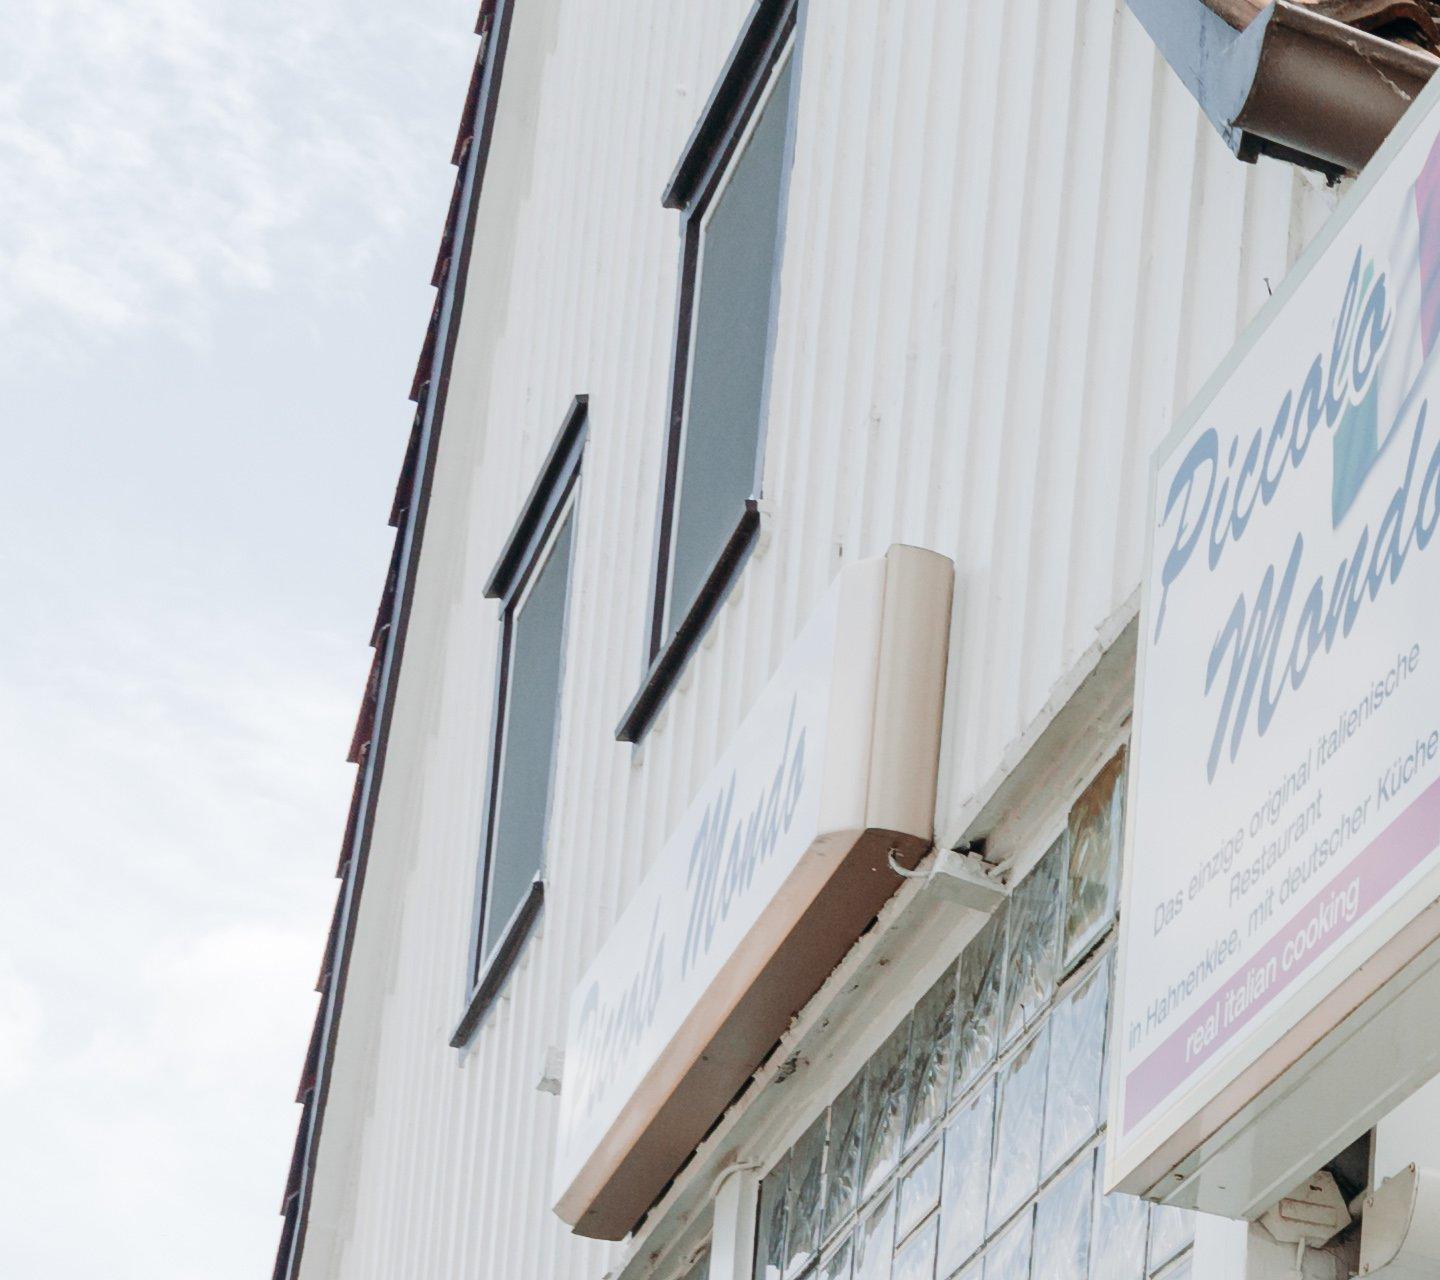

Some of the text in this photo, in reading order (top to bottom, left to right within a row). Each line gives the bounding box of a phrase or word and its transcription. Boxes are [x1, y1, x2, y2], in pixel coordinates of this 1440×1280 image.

[1154, 244, 1391, 646] Piccolo
[681, 691, 806, 982] Mondo
[1129, 1018, 1142, 1052] in
[1146, 928, 1242, 1036] Hahnenklee,
[1248, 890, 1275, 937] mit
[1279, 796, 1370, 907] deutscher
[1153, 642, 1420, 937] Das einzige original italienische
[1228, 789, 1323, 908] Restaurant
[1185, 877, 1361, 1063] real italian cooking
